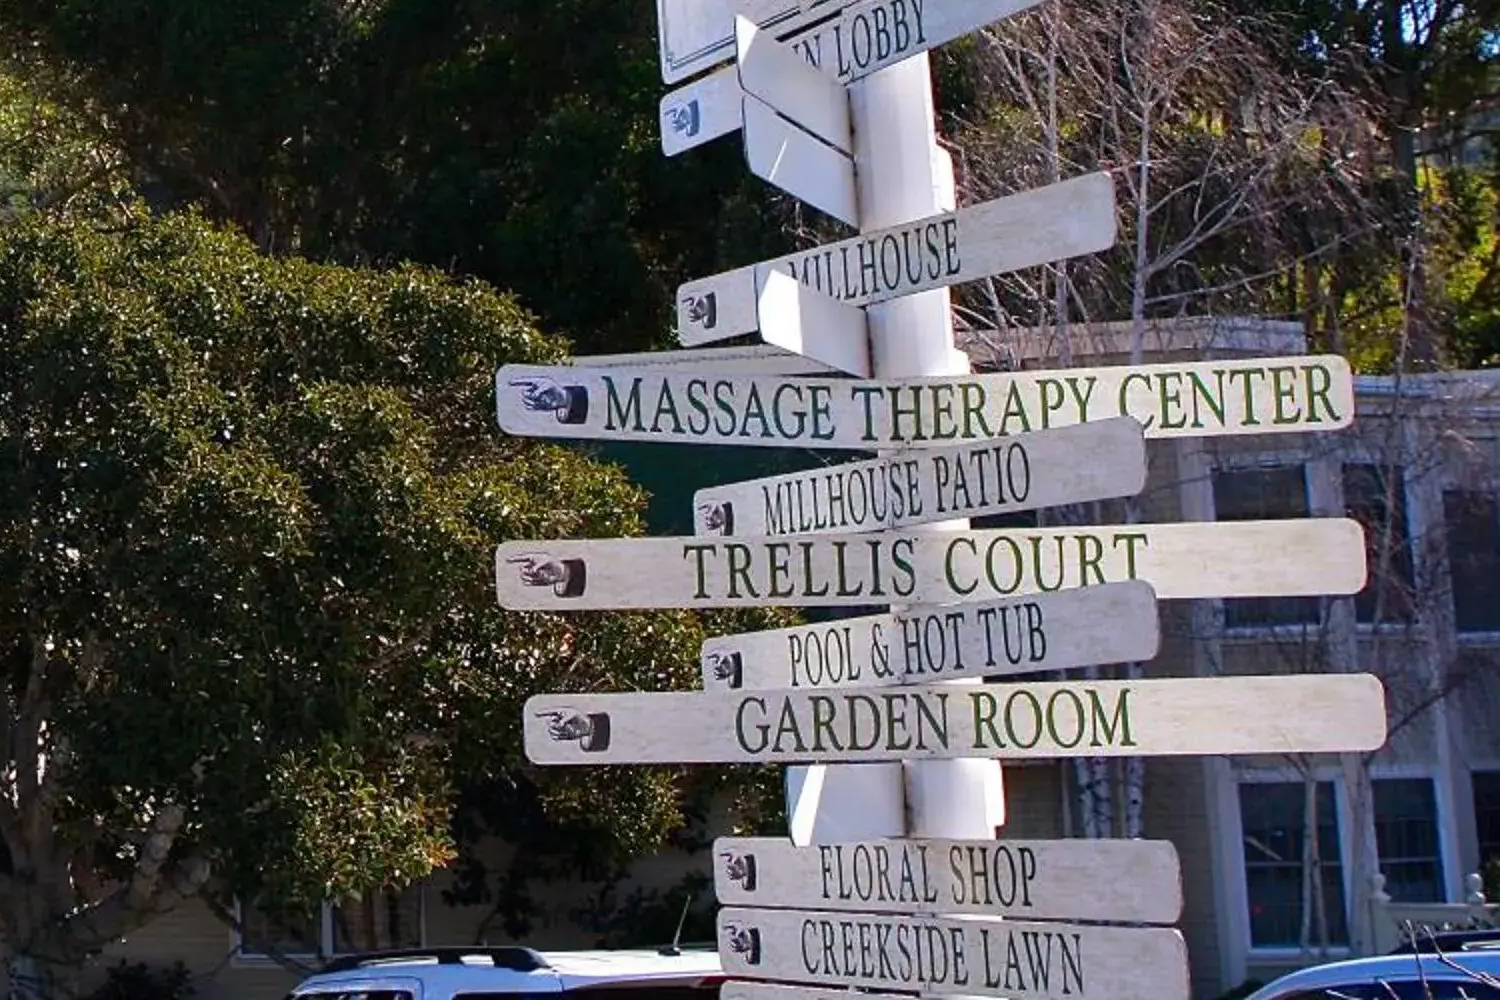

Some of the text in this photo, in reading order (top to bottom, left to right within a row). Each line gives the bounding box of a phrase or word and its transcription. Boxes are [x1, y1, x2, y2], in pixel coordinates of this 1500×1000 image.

[601, 363, 1342, 441] MASSAGE THERAPY CENTER
[762, 442, 1031, 537] MILLHOUSE PATIO
[684, 533, 1150, 600] TRELLIS COURT
[788, 602, 1048, 687] POOL & HOT TUB
[735, 688, 1138, 753] GARDEN ROOM
[818, 844, 1038, 907] FLORAL SHOP
[800, 918, 1087, 995] CREEKSIDE LAWN
